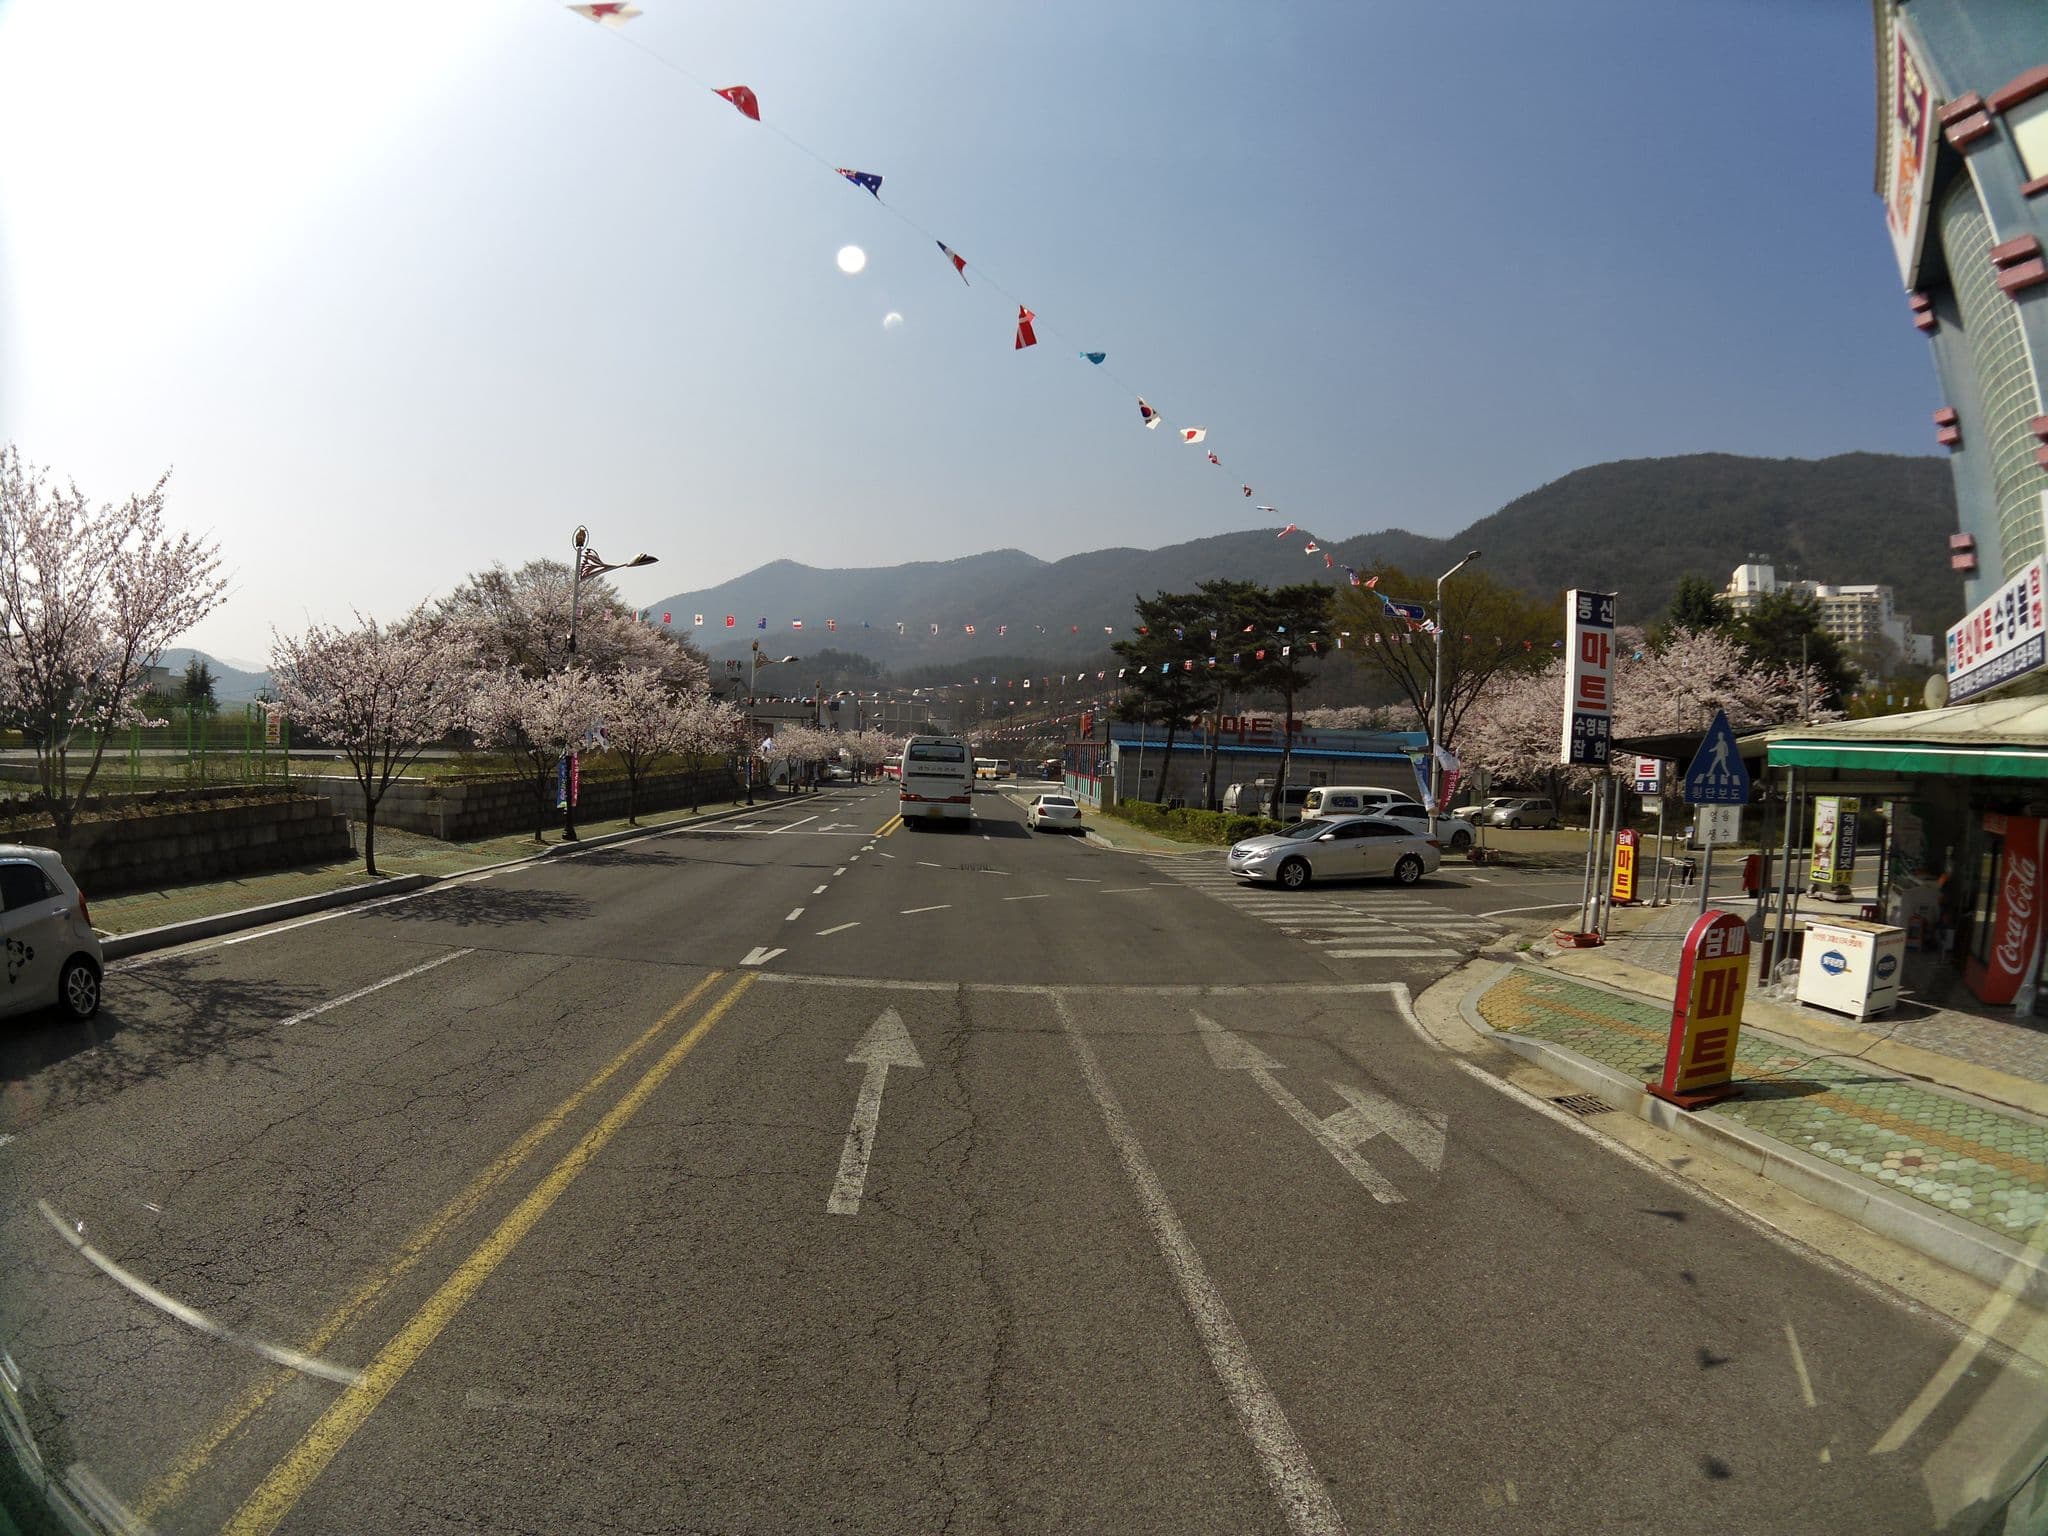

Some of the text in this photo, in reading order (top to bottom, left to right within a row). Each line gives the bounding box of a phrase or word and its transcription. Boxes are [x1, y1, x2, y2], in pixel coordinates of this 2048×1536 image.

[1577, 632, 1610, 711] 마트
[1575, 717, 1608, 738] 수영복
[1573, 739, 1607, 761] 잡화
[1710, 810, 1729, 824] 얼음
[1615, 849, 1631, 894] 마트
[1705, 925, 1745, 958] 담배
[1684, 967, 1740, 1080] 마트
